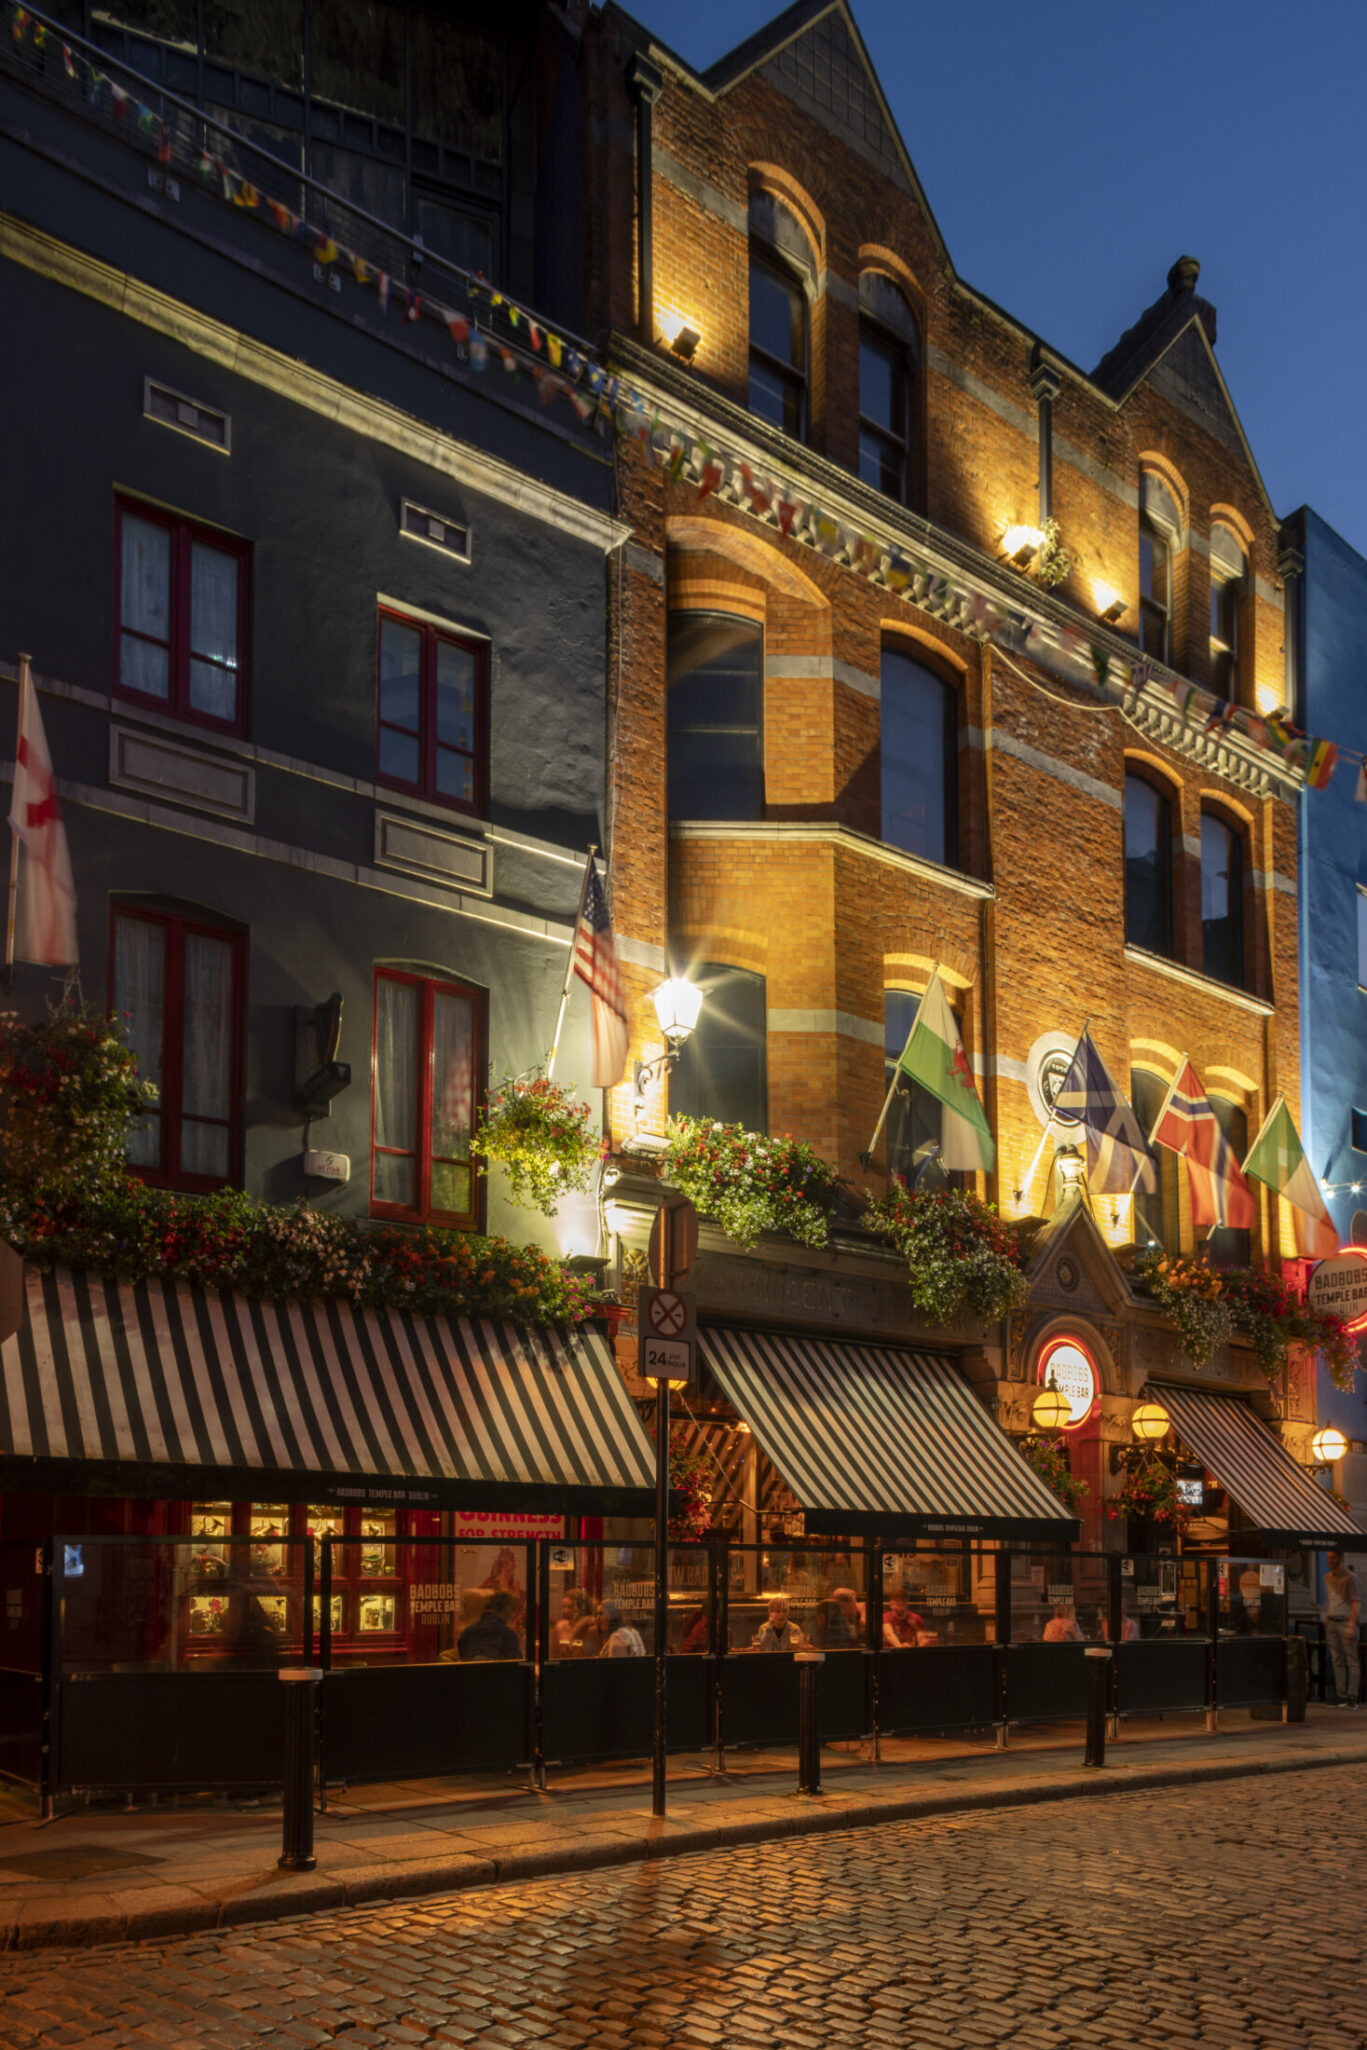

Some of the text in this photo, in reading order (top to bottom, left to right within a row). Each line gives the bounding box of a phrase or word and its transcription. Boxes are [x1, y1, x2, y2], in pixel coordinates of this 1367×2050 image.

[1315, 1267, 1367, 1289] BADBOBS
[1316, 1289, 1351, 1305] TEMPLE
[648, 1350, 666, 1366] 24
[409, 1583, 461, 1600] BADBOBS
[410, 1600, 461, 1613] TEMPLE BAR
[421, 1613, 450, 1625] DUBLIN
